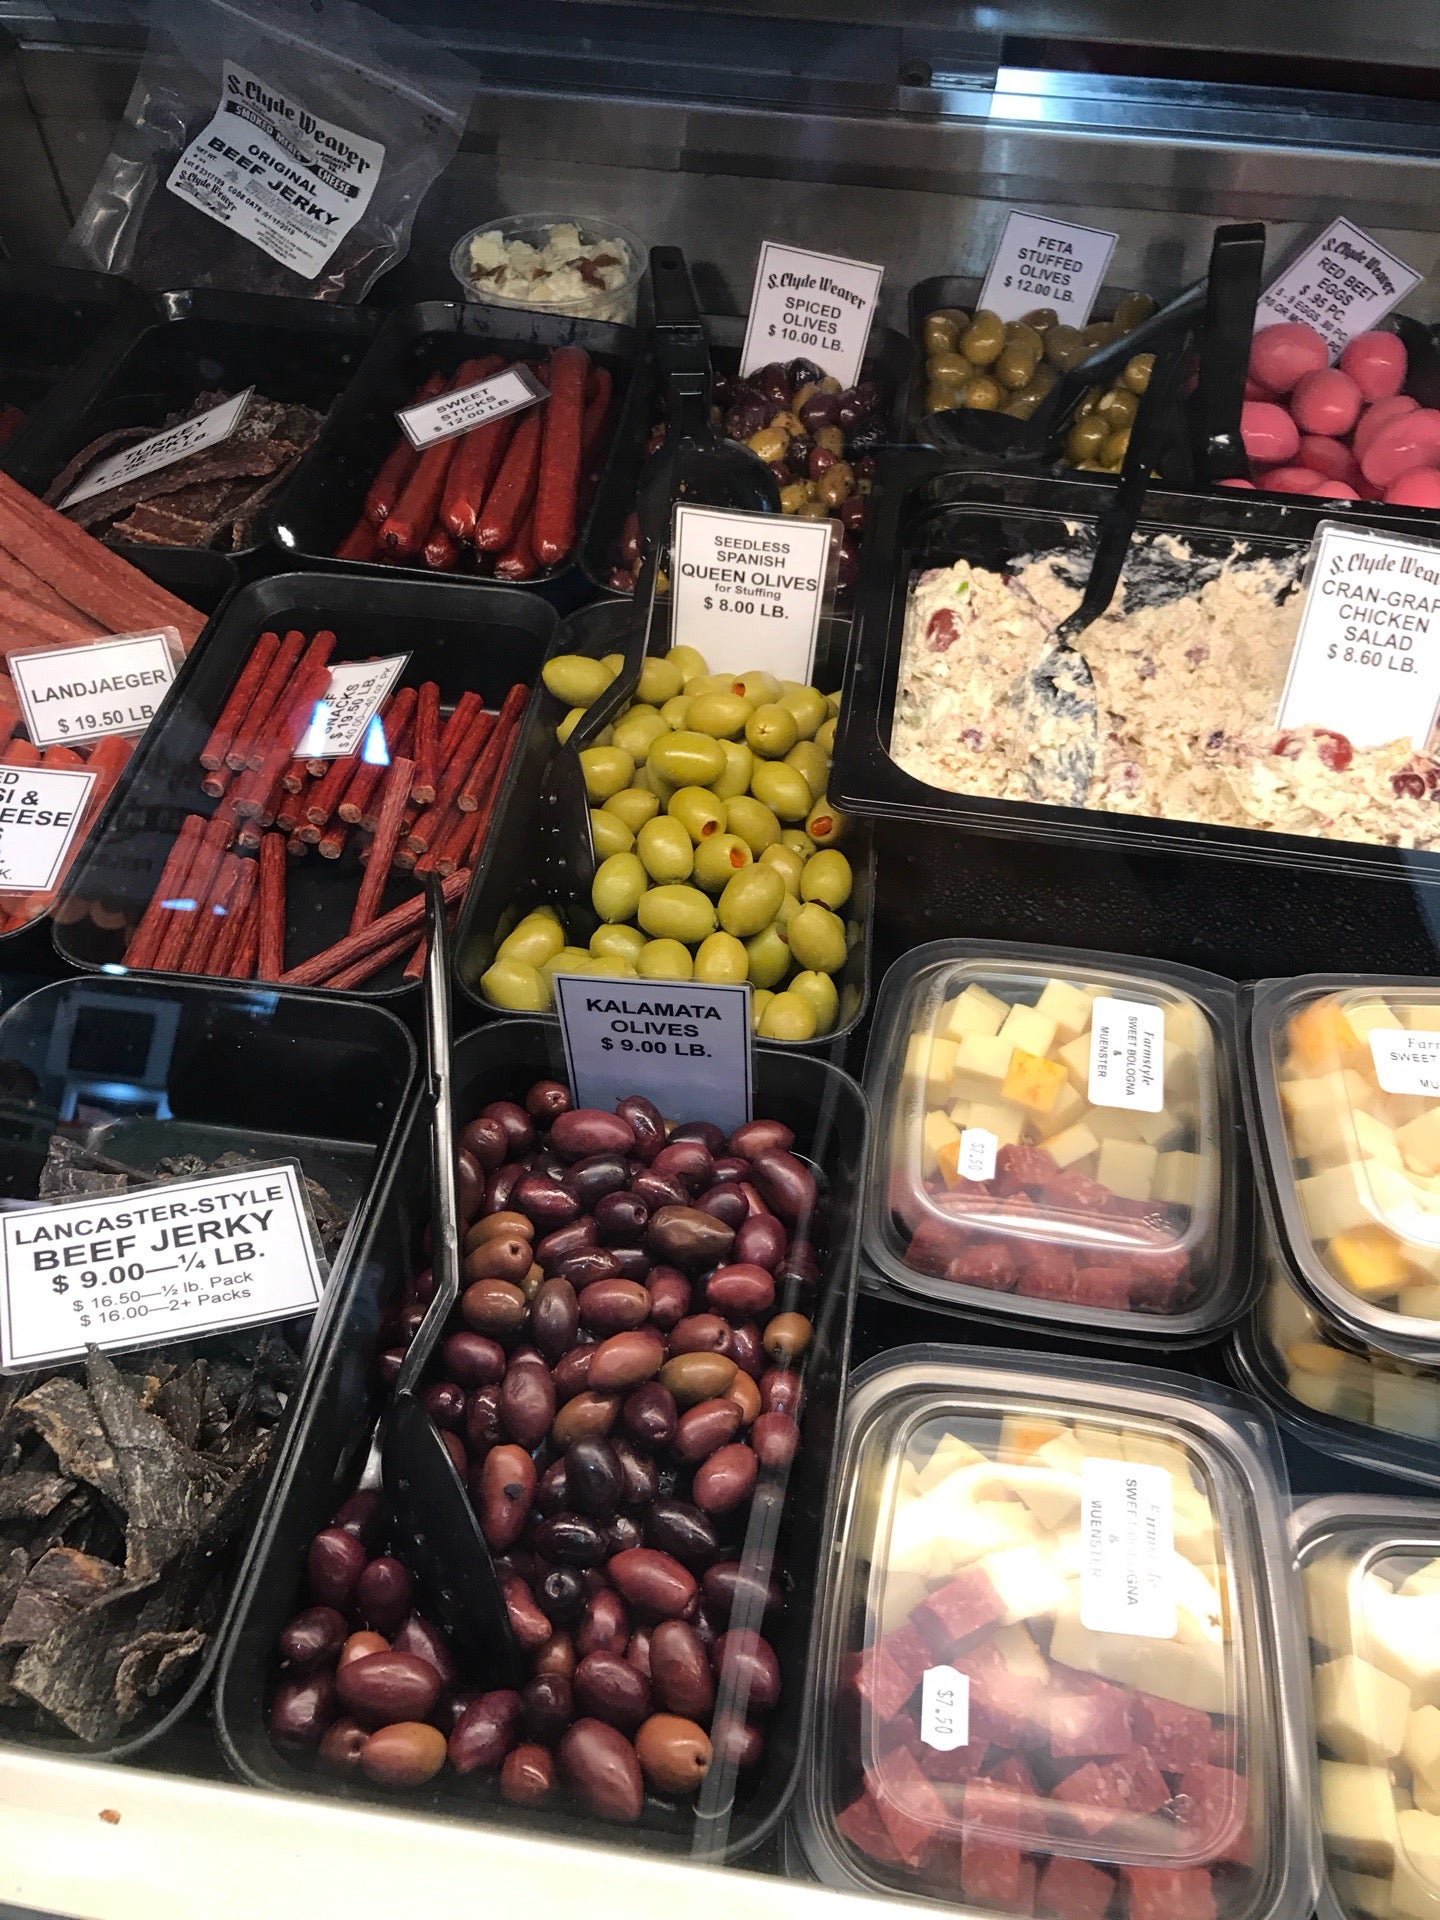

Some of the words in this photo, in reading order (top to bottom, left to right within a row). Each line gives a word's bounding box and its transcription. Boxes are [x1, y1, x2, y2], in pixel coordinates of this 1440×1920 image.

[228, 75, 244, 96] S.
[245, 80, 295, 121] Clyde
[300, 110, 370, 174] Weaver
[236, 105, 273, 134] SMOKED
[318, 168, 352, 194] CHEESE
[208, 136, 266, 175] BEEF
[268, 180, 340, 226] JERKY
[248, 144, 317, 197] ORIGINAL
[1038, 236, 1073, 255] FETA
[1018, 248, 1083, 273] STUFFED
[1020, 264, 1071, 286] OLIVES
[768, 274, 779, 289] S.
[780, 273, 817, 290] Clyde
[819, 277, 866, 310] Weaver
[1004, 275, 1013, 287] $
[1017, 280, 1050, 297] 12.00
[1054, 288, 1074, 303] LB.
[1317, 277, 1354, 306] EGGS
[1318, 257, 1346, 280] RED
[1343, 275, 1378, 302] BEET
[785, 297, 841, 319] SPICED
[768, 324, 776, 337] $
[781, 328, 817, 346] 10.00
[822, 337, 844, 352] LB.
[783, 313, 837, 335] OLIVES
[436, 387, 489, 413] SWEET
[441, 395, 497, 421] STICKS
[447, 409, 485, 427] 12.00
[123, 430, 196, 467] JERKY
[125, 417, 209, 460] TURKEY
[714, 535, 791, 554] SEEDLESS
[716, 551, 786, 568] SPANISH
[1330, 555, 1344, 576] S.
[1347, 553, 1396, 575] Clyde
[681, 563, 745, 584] QUEEN
[751, 572, 817, 592] OLIVES
[714, 583, 731, 594] for
[735, 585, 781, 601] Stuffing
[703, 596, 713, 610] $
[719, 599, 755, 614] 8.00
[760, 604, 789, 619] LB.
[1339, 604, 1430, 634] CHICKEN
[1344, 626, 1413, 651] SALAD
[1327, 643, 1338, 659] $
[1343, 647, 1383, 667] 8.60
[1388, 656, 1418, 674] LB.
[31, 669, 168, 704] LANDJAEGER
[338, 699, 363, 729] 19.50
[358, 675, 378, 695] LB.
[57, 718, 70, 734] $
[75, 710, 124, 731] 19.50
[21, 790, 39, 806] &
[586, 998, 722, 1020] KALAMATA
[611, 1019, 699, 1037] OLIVES
[1127, 1015, 1138, 1047] SWEET
[601, 1037, 614, 1051] $
[621, 1039, 667, 1054] 9.00
[675, 1043, 712, 1058] LB.
[1098, 1026, 1110, 1077] MUENSTER
[1138, 1031, 1154, 1086] Farmstyle
[1390, 1051, 1437, 1063] SWEET
[1125, 1049, 1137, 1096] BOLOGNA
[15, 1185, 284, 1246] LANCASTER-STYLE
[33, 1235, 136, 1272] BEEF
[150, 1209, 274, 1251] JERKY
[52, 1274, 69, 1295] $
[215, 1242, 265, 1266] LB.
[73, 1300, 84, 1312] $
[183, 1282, 204, 1293] lb.
[210, 1271, 254, 1288] Pack
[80, 1314, 91, 1327] $
[198, 1289, 252, 1306] Packs
[935, 1689, 954, 1734] $7.50
